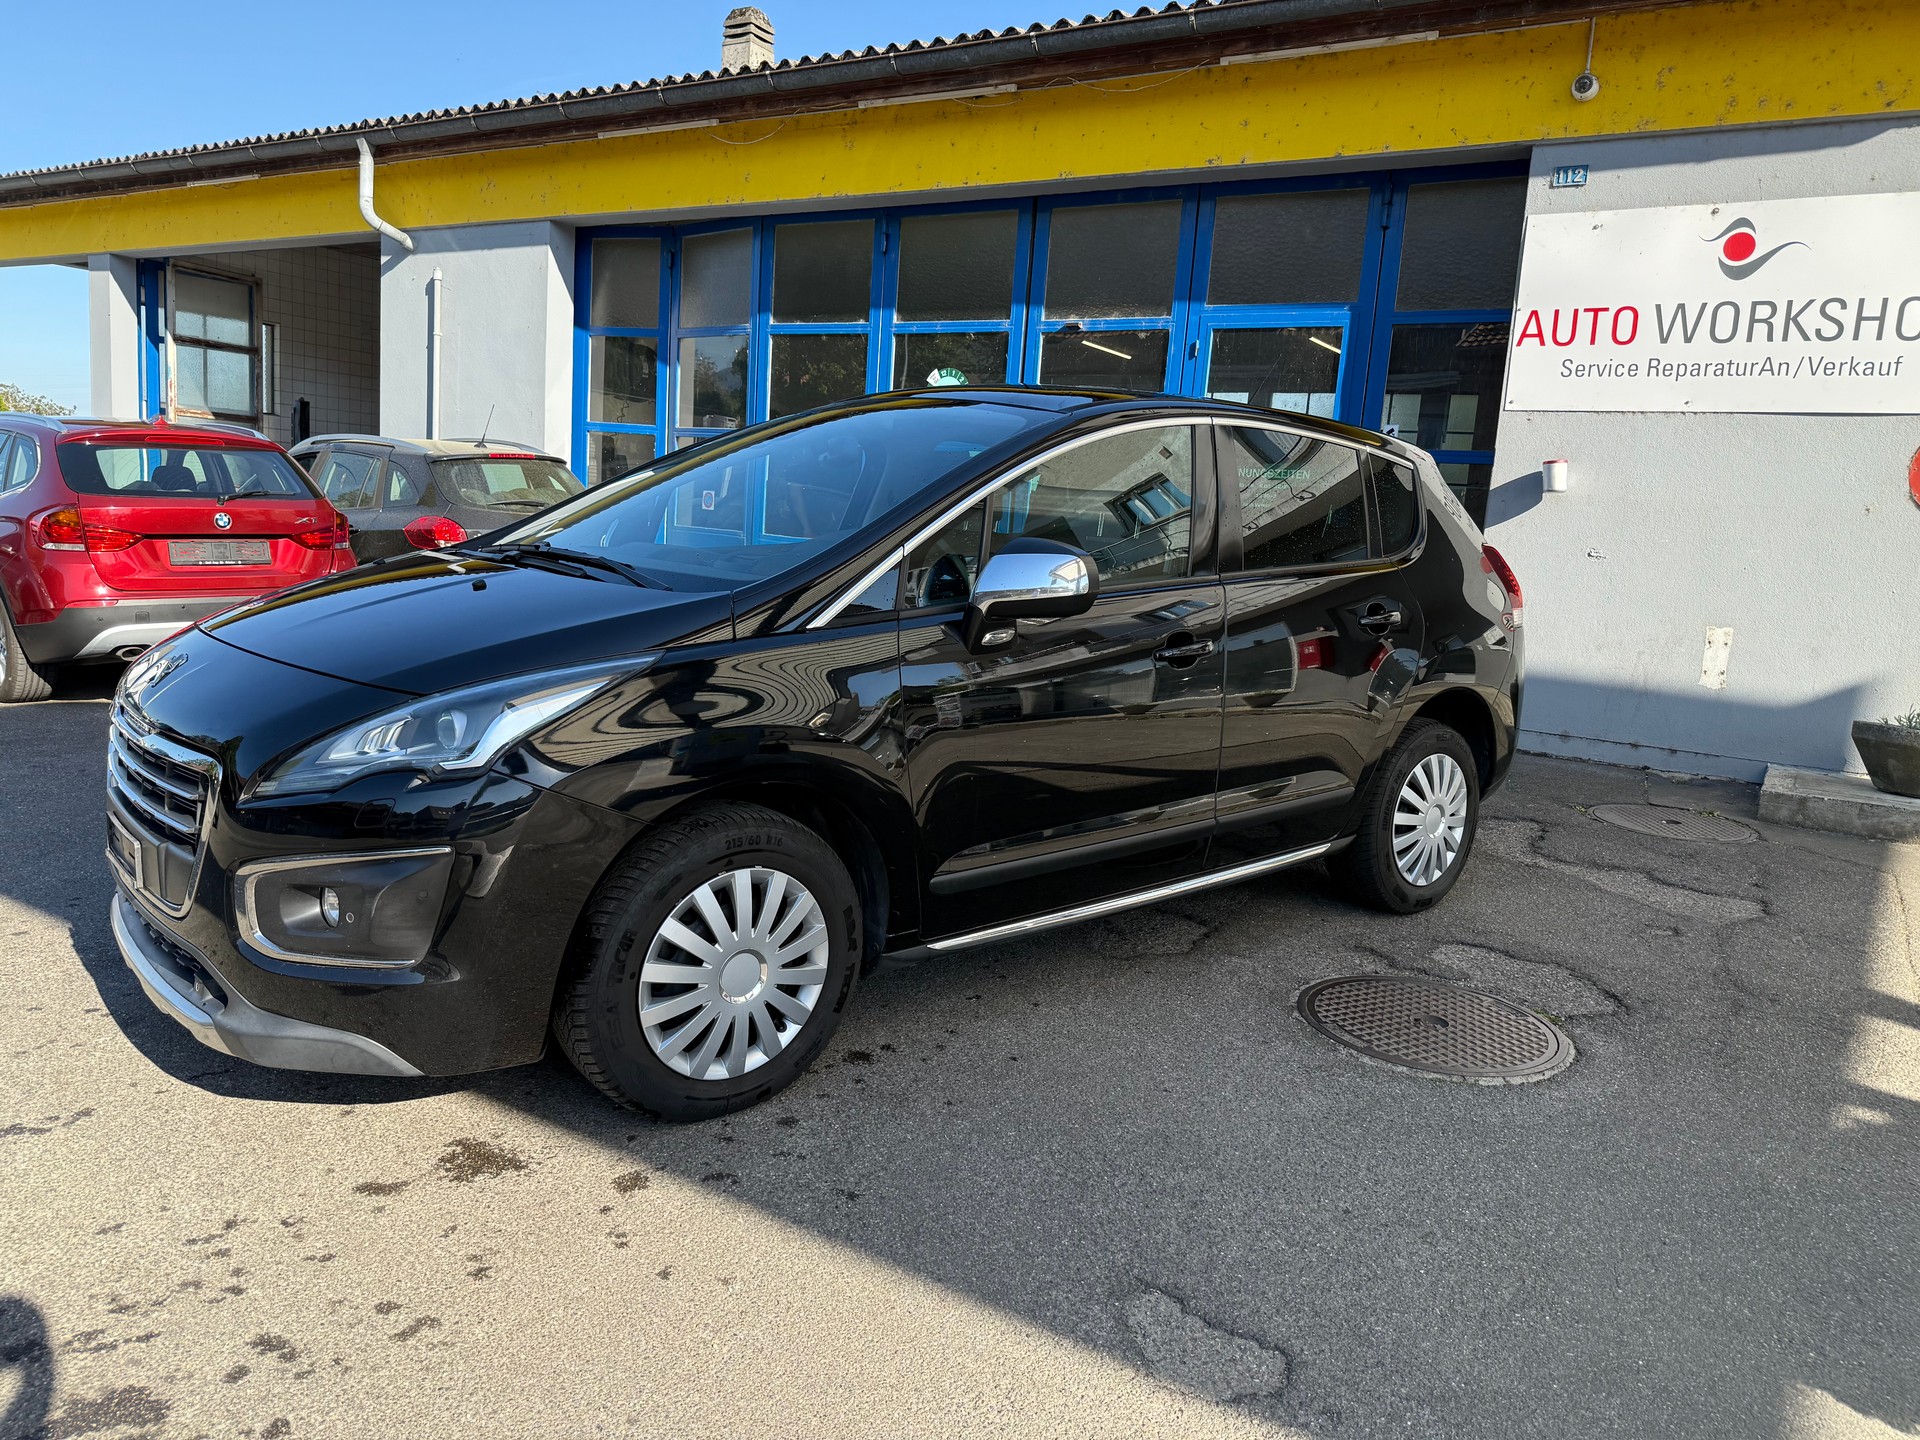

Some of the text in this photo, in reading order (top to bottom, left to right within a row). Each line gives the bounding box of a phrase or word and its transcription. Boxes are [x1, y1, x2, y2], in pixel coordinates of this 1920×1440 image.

[1558, 168, 1584, 184] 112
[1516, 296, 1920, 347] AUTO WORKSHO
[1560, 355, 1904, 382] Service ReparaturAn/Verkauf
[294, 516, 318, 525] X1
[725, 834, 761, 850] 215/60
